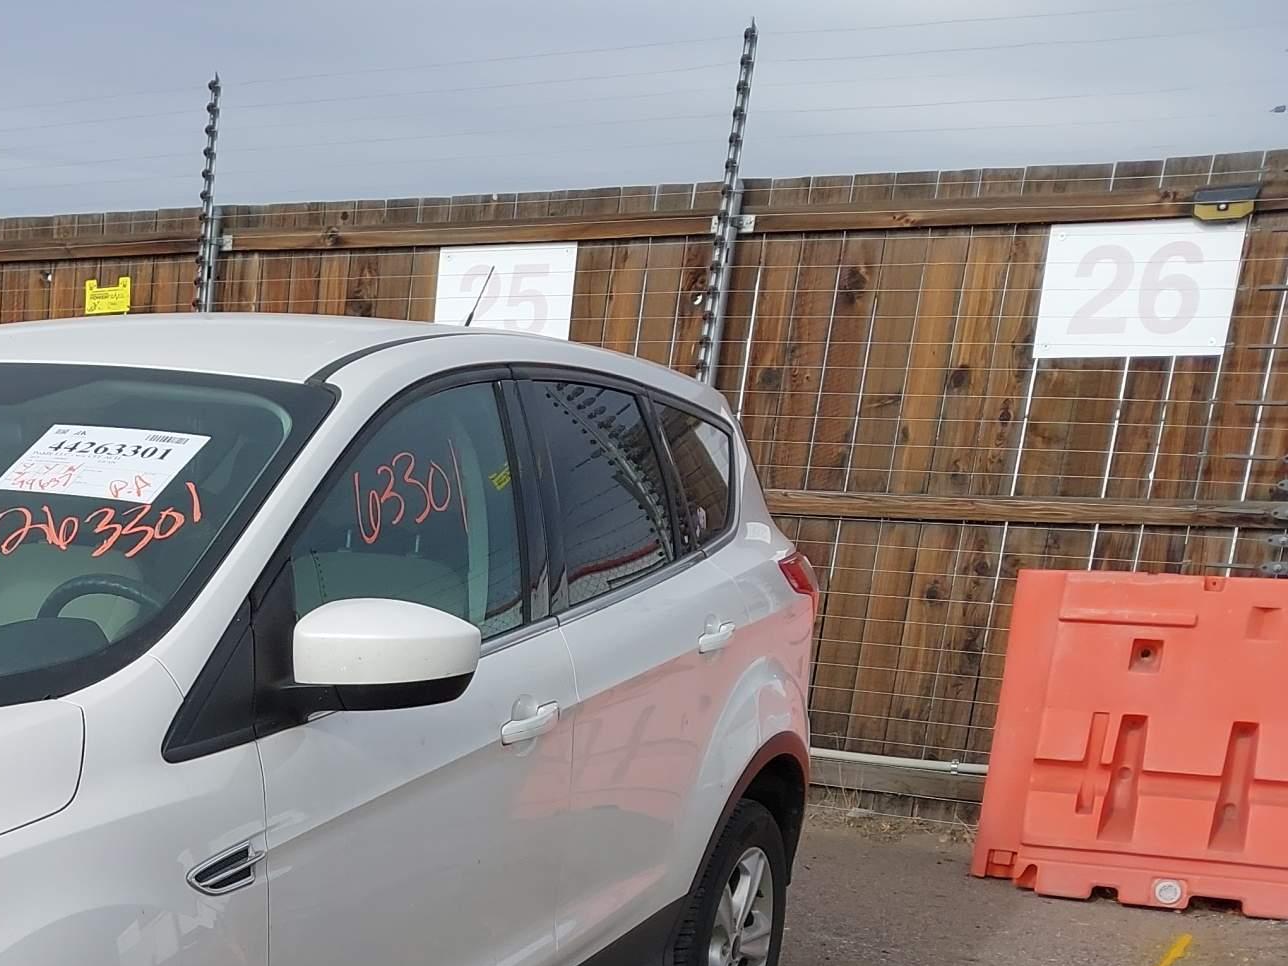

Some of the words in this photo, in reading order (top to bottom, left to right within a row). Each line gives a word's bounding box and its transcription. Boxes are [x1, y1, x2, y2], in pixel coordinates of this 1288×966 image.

[459, 263, 550, 333] 25
[1066, 240, 1204, 335] 26
[48, 440, 173, 461] 44263301
[354, 439, 469, 544] 63301
